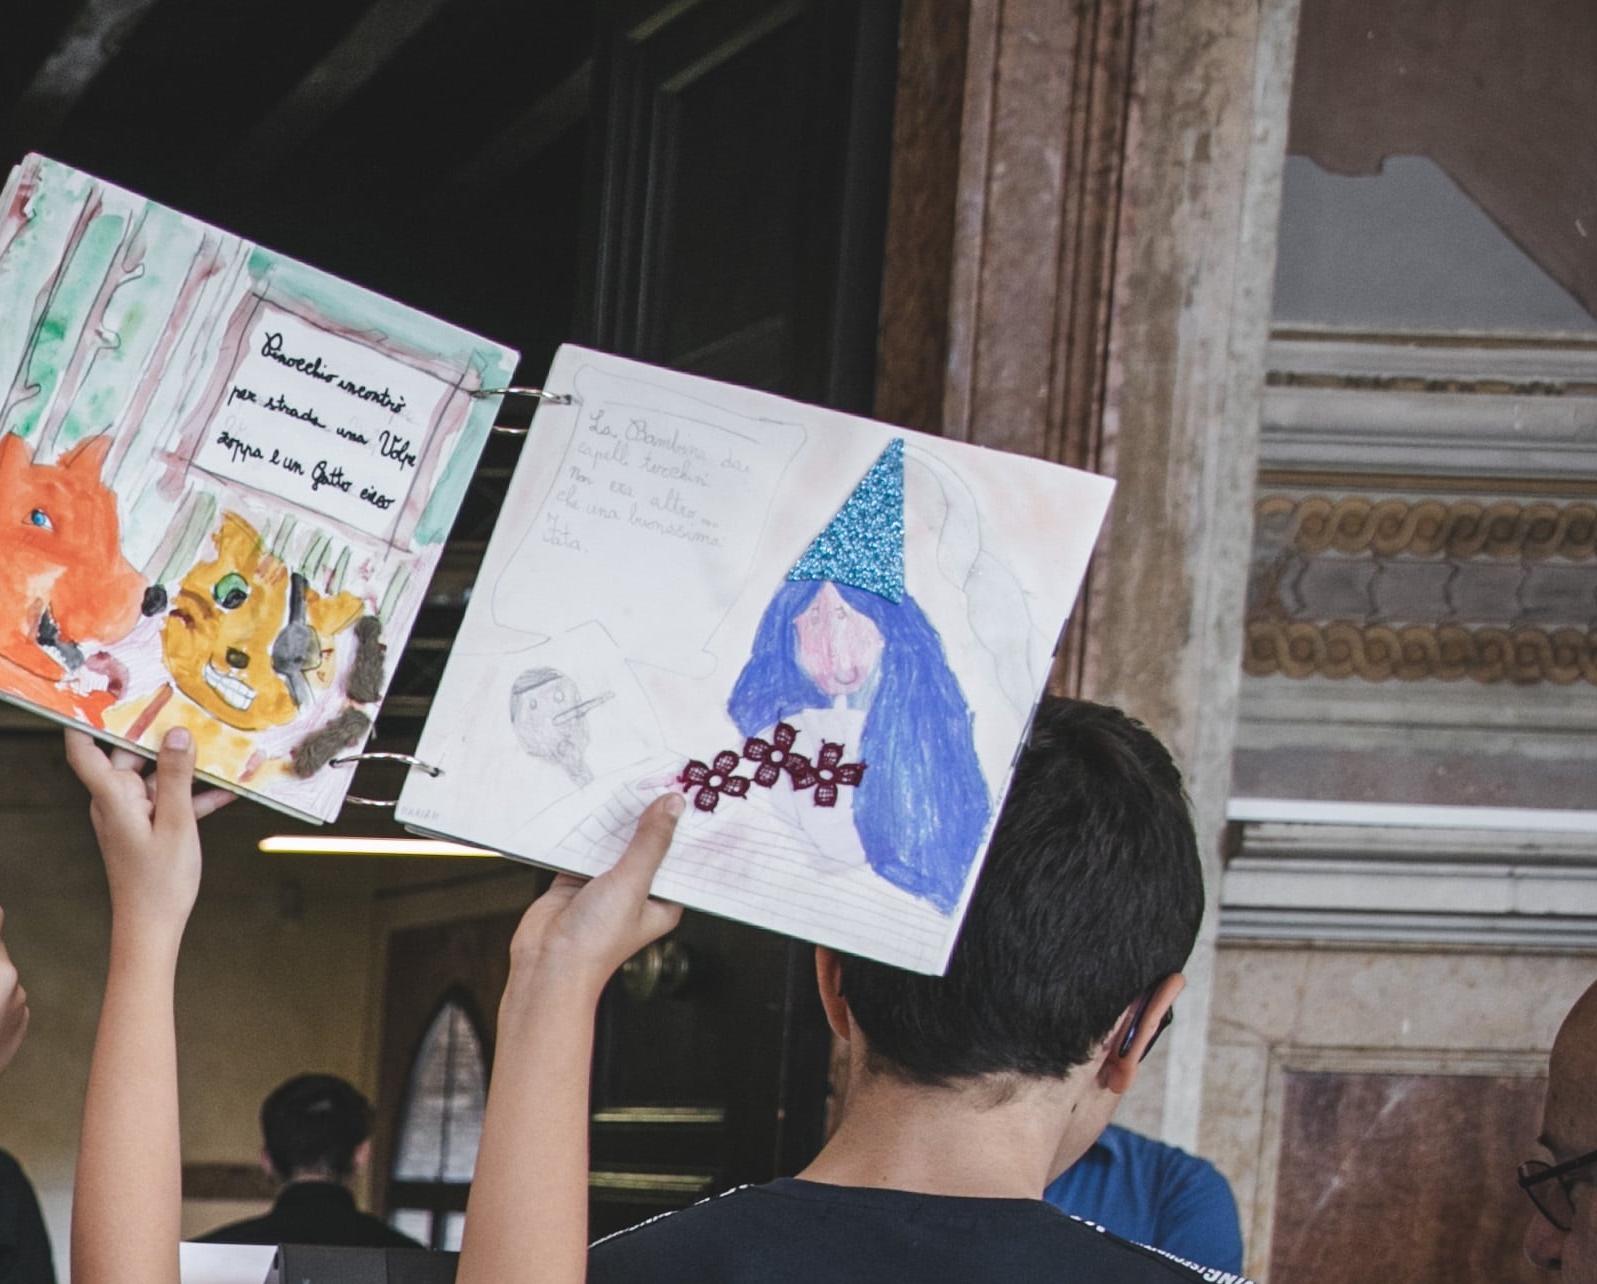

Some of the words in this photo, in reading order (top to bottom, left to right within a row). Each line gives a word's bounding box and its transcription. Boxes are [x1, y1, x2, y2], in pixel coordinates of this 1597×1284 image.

[261, 331, 338, 382] Pinocchio
[227, 385, 257, 406] per
[264, 395, 327, 429] strada
[336, 426, 368, 446] una
[379, 430, 416, 470] Volpe
[283, 459, 305, 476] un
[311, 461, 352, 491] Gatto
